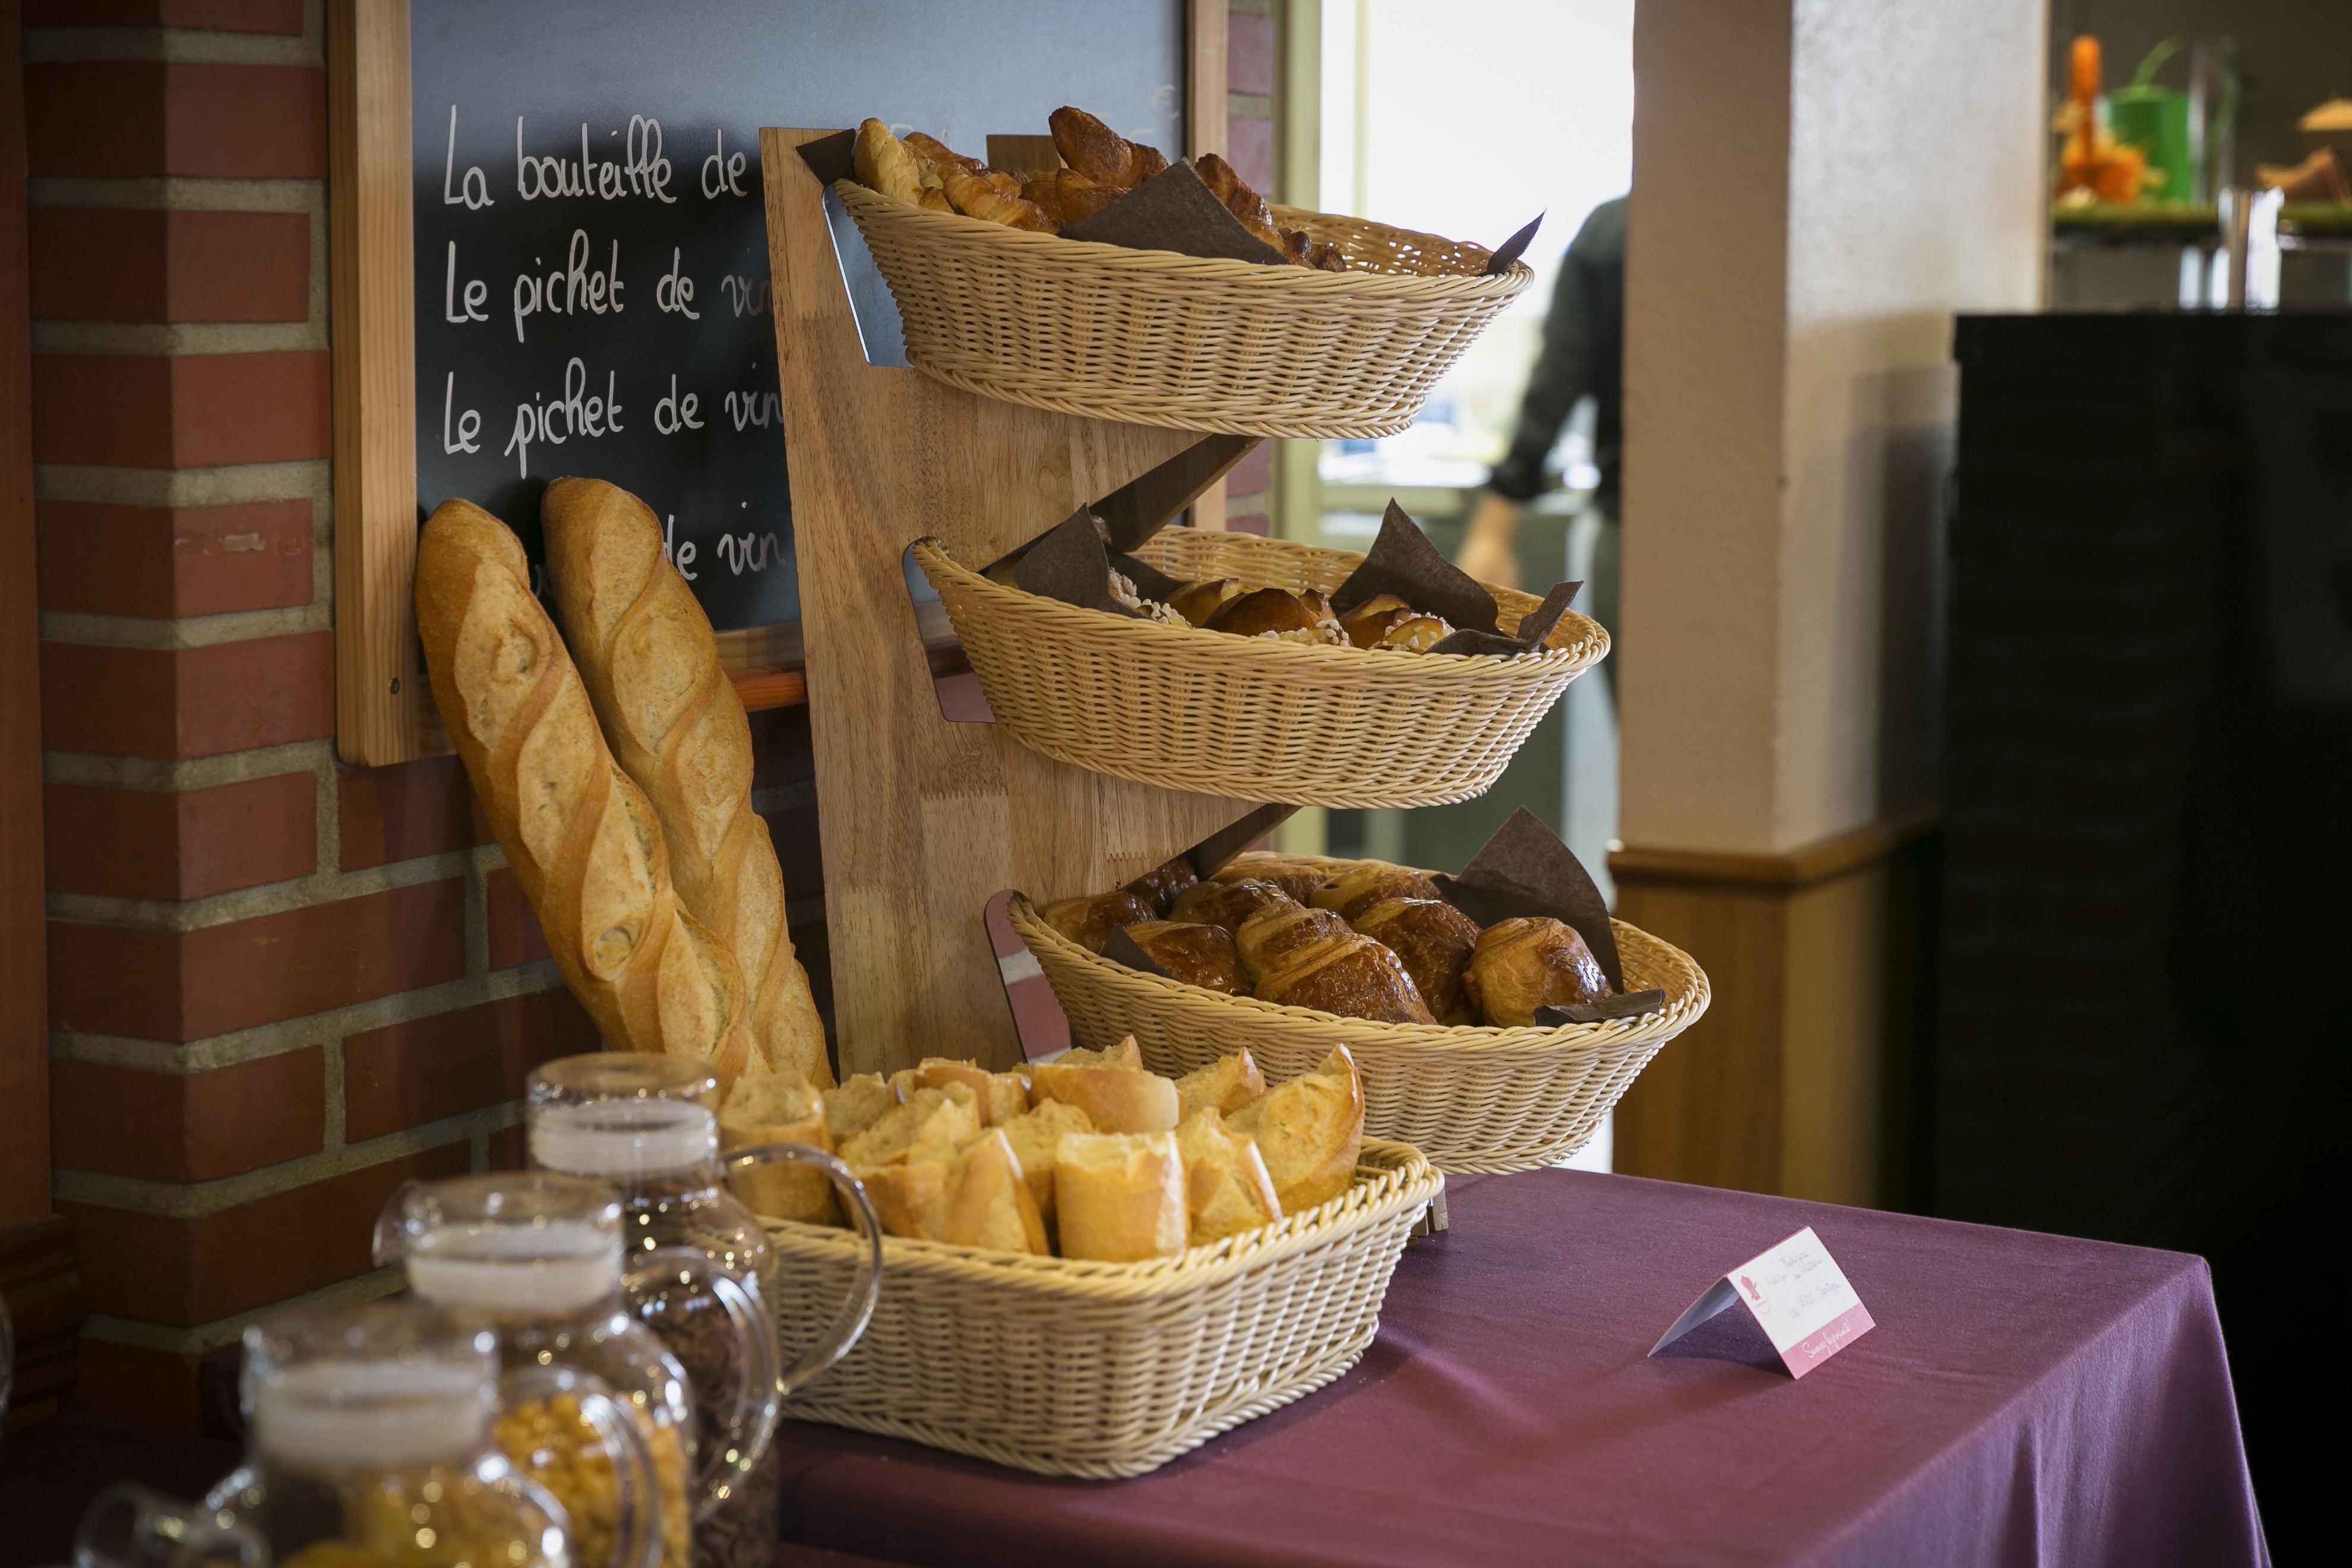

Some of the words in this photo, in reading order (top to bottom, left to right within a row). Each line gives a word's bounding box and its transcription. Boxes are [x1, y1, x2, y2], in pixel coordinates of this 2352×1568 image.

[444, 104, 495, 210] La
[517, 114, 677, 203] bouteille
[701, 128, 748, 199] de
[445, 241, 489, 323] Le
[514, 229, 624, 344] pichet
[656, 246, 700, 319] de
[443, 371, 481, 454] Le
[504, 357, 624, 479] pichet
[654, 374, 704, 435] de
[724, 361, 784, 432] vin
[717, 501, 786, 576] vin
